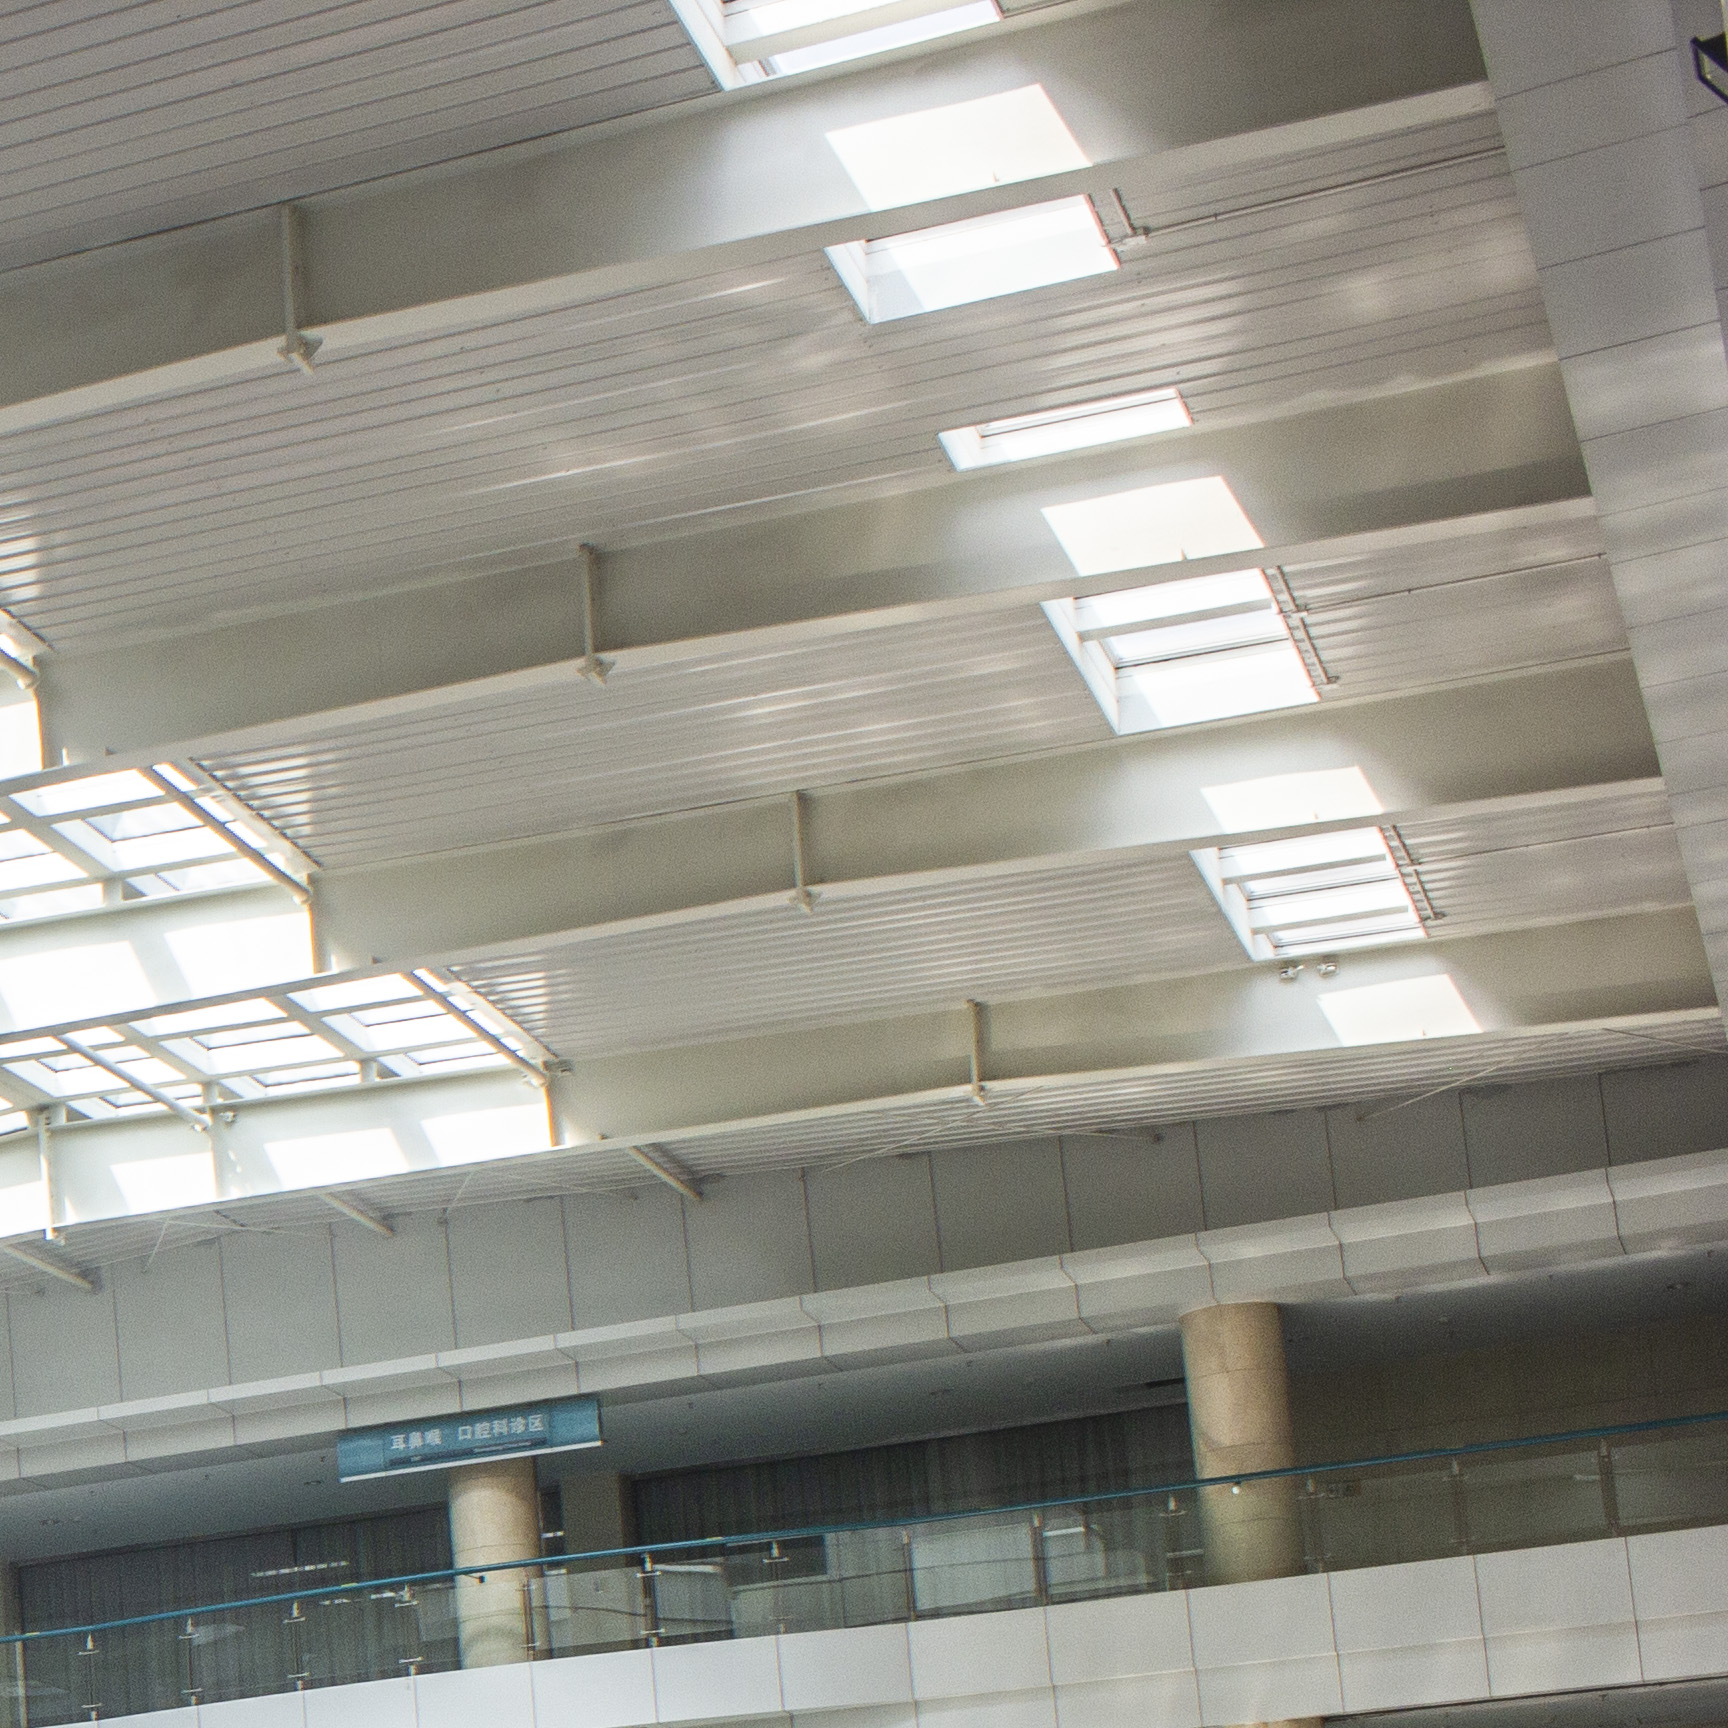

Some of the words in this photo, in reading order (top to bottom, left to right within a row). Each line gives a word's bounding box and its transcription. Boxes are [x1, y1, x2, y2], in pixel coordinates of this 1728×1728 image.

[390, 1429, 442, 1450] 耳鼻喉
[458, 1414, 544, 1440] 口腔科诊区
